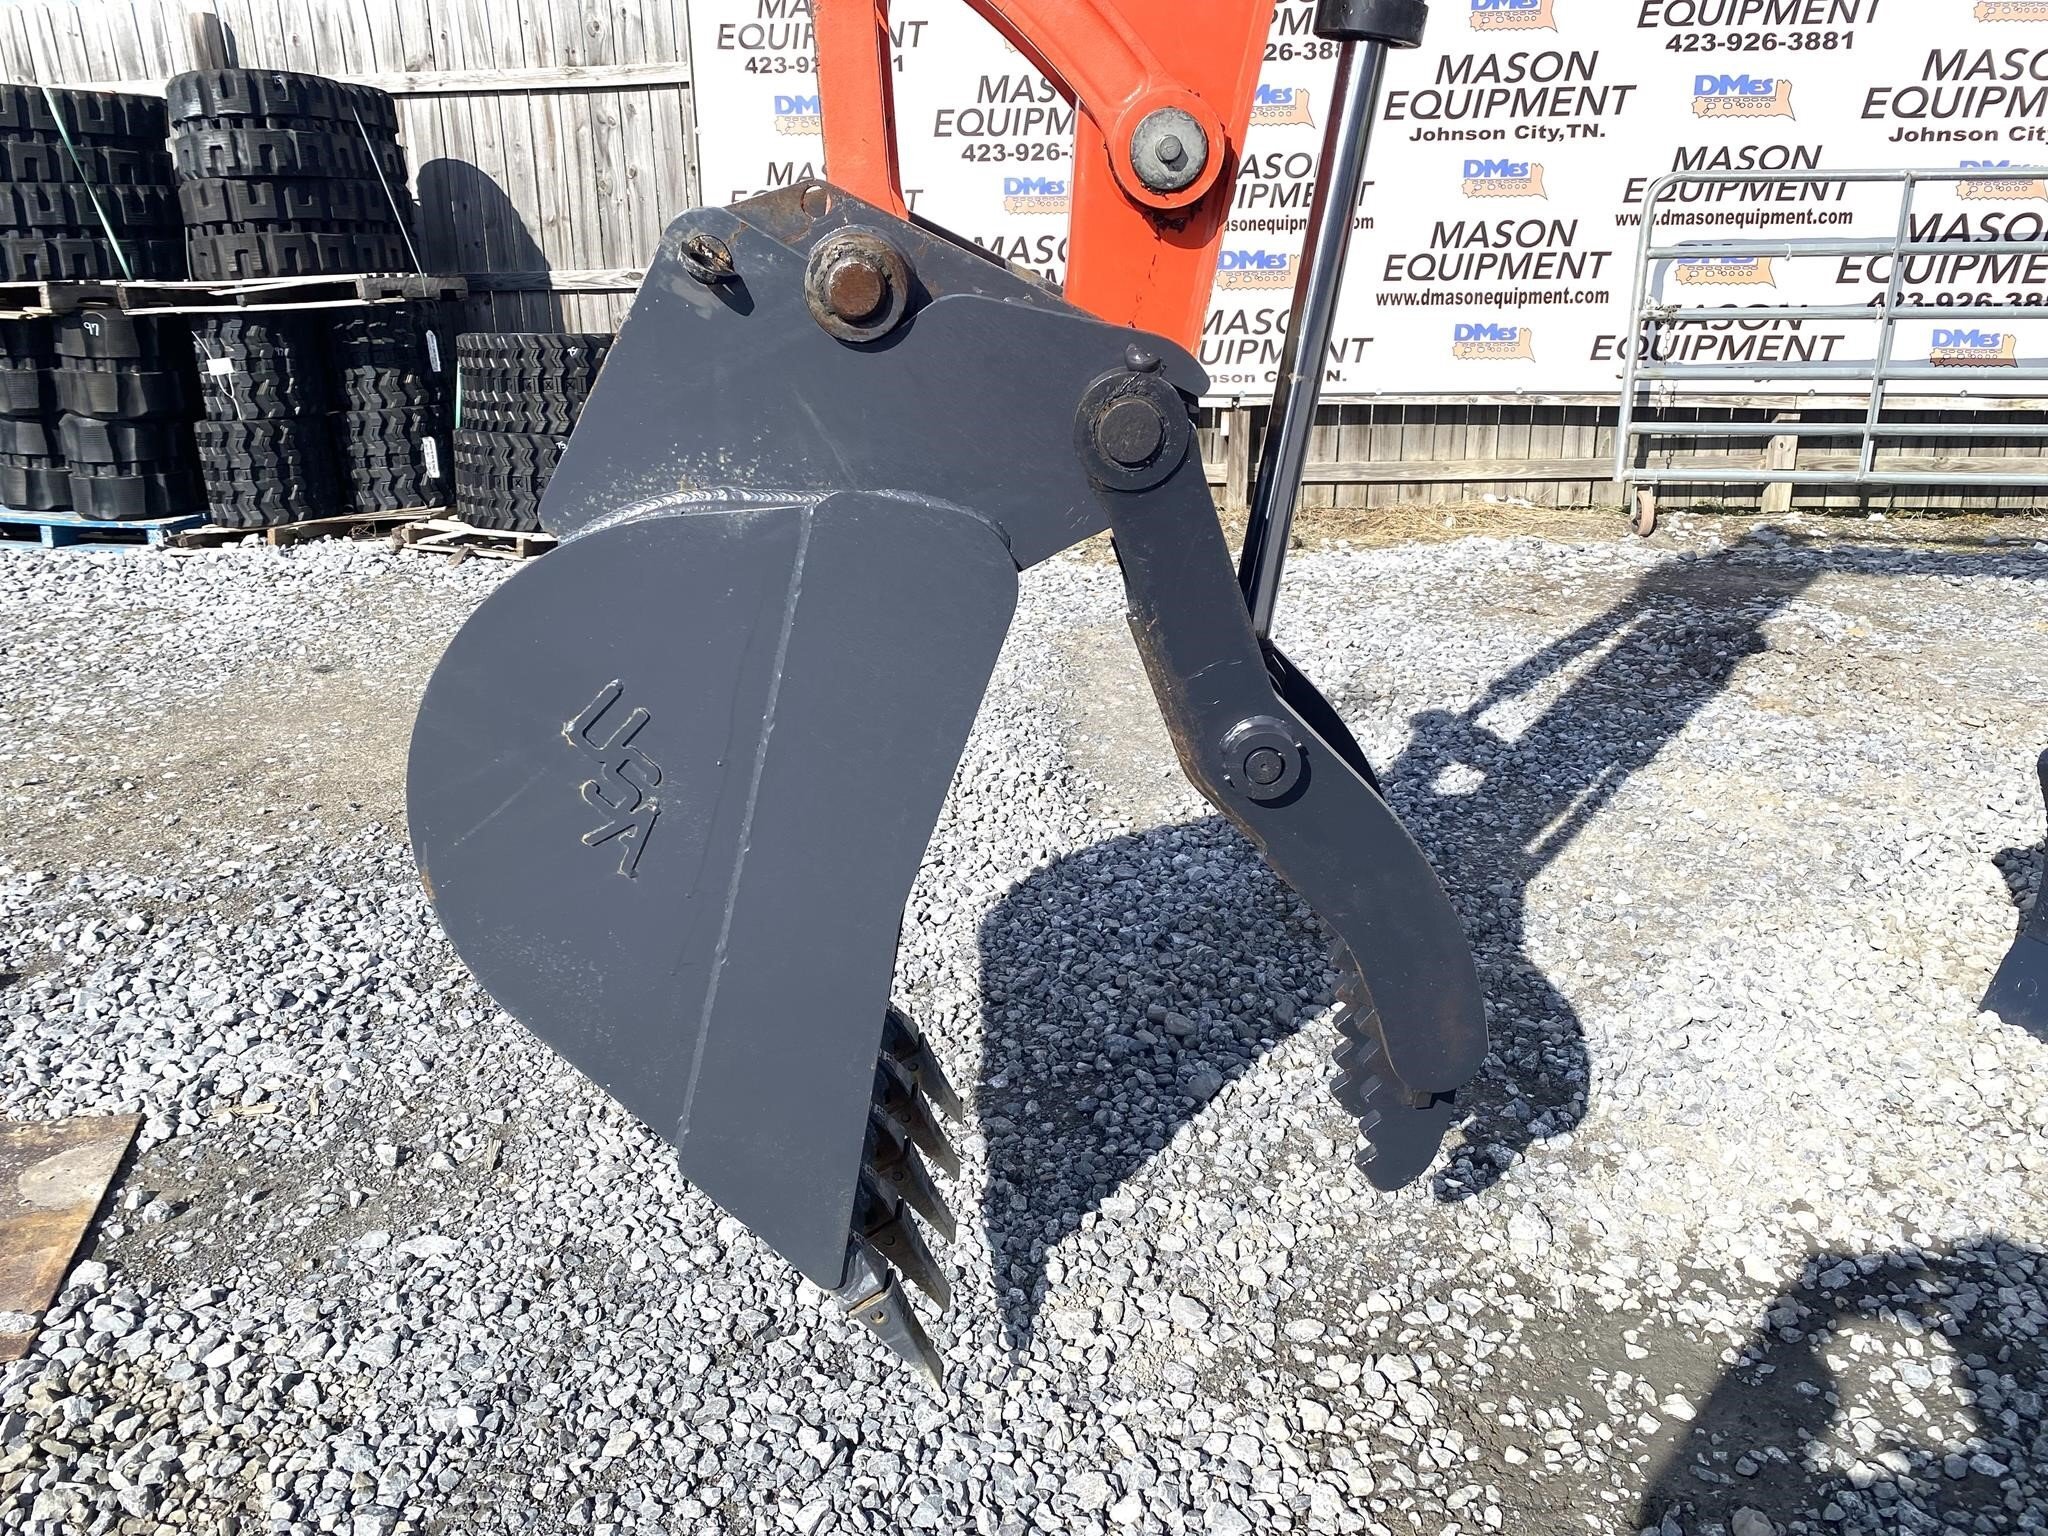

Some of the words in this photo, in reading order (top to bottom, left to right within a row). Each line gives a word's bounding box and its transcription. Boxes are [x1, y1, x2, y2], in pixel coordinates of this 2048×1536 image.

[1665, 31, 1854, 52] 423-926-3881
[1435, 50, 1599, 85] MASON
[977, 74, 1056, 103] MAS
[1383, 85, 1637, 121] EQUIPMENT
[1861, 86, 2048, 119] EQUIPM
[933, 107, 1074, 137] EQUIPM
[1409, 127, 1505, 142] Johnson
[1888, 127, 1999, 142] Johnson
[961, 143, 1073, 163] 423-926-
[1671, 145, 1823, 172] MASON
[1615, 209, 1853, 229] ww.dmasonequipment.com
[1909, 212, 2048, 243] MASO
[1429, 219, 1578, 249] MASON
[1383, 251, 1612, 282] EQUIPMENT
[1376, 287, 1610, 309] www.dmasonequipment.com
[83, 321, 99, 337] 97
[561, 678, 664, 880] USA
